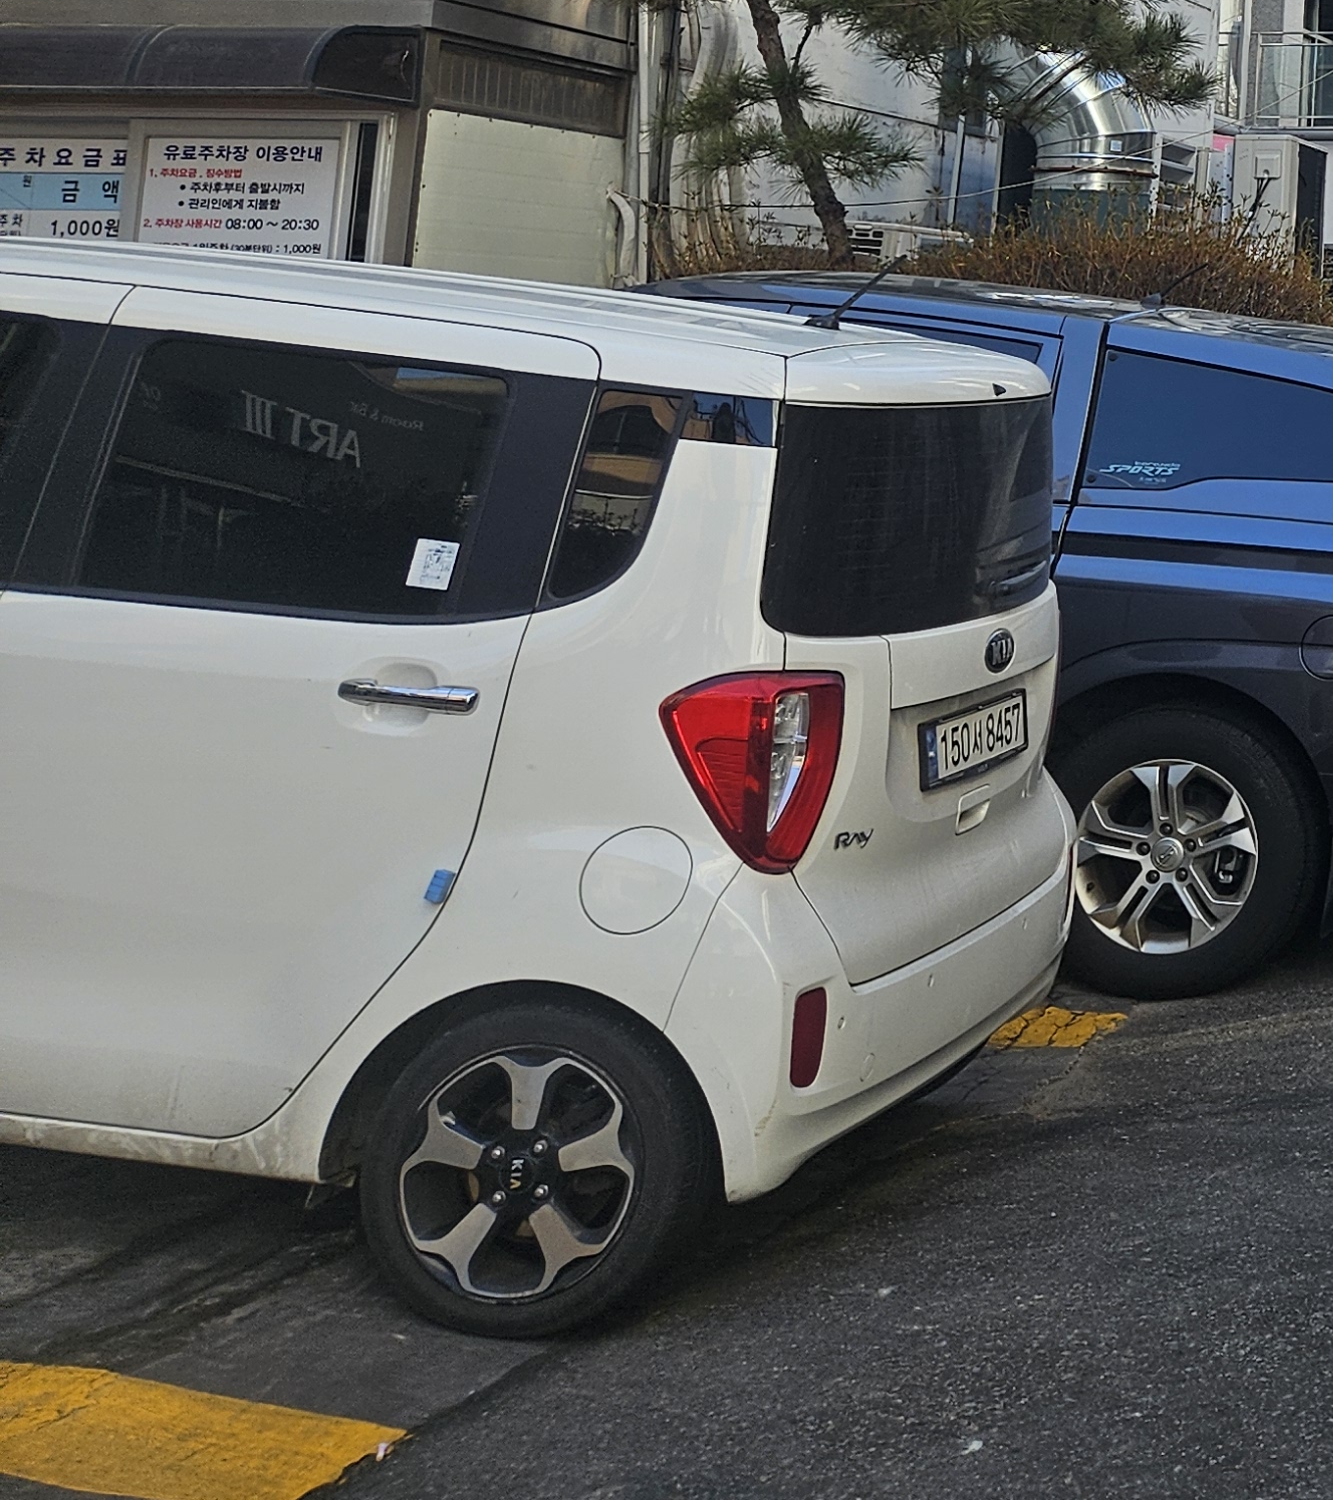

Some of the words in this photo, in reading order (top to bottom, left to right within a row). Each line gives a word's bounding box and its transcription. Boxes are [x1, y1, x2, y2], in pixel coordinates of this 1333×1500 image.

[163, 144, 249, 162] 유료주차장
[256, 145, 323, 163] 이용안내
[160, 168, 197, 179] 주차요금
[189, 182, 245, 194] 주차후부터
[248, 183, 305, 195] 출발시까지
[188, 198, 244, 210] 관리인에게
[247, 199, 281, 211] 지불함
[51, 219, 120, 238] 1,000원
[155, 218, 184, 229] 주차장
[185, 218, 222, 229] 사용시간
[225, 218, 263, 231] 08:00
[281, 219, 320, 231] 20:30
[283, 243, 322, 255] 1,000원
[1099, 464, 1179, 476] SPORTS
[990, 638, 1014, 665] KIA
[833, 828, 874, 850] RAY
